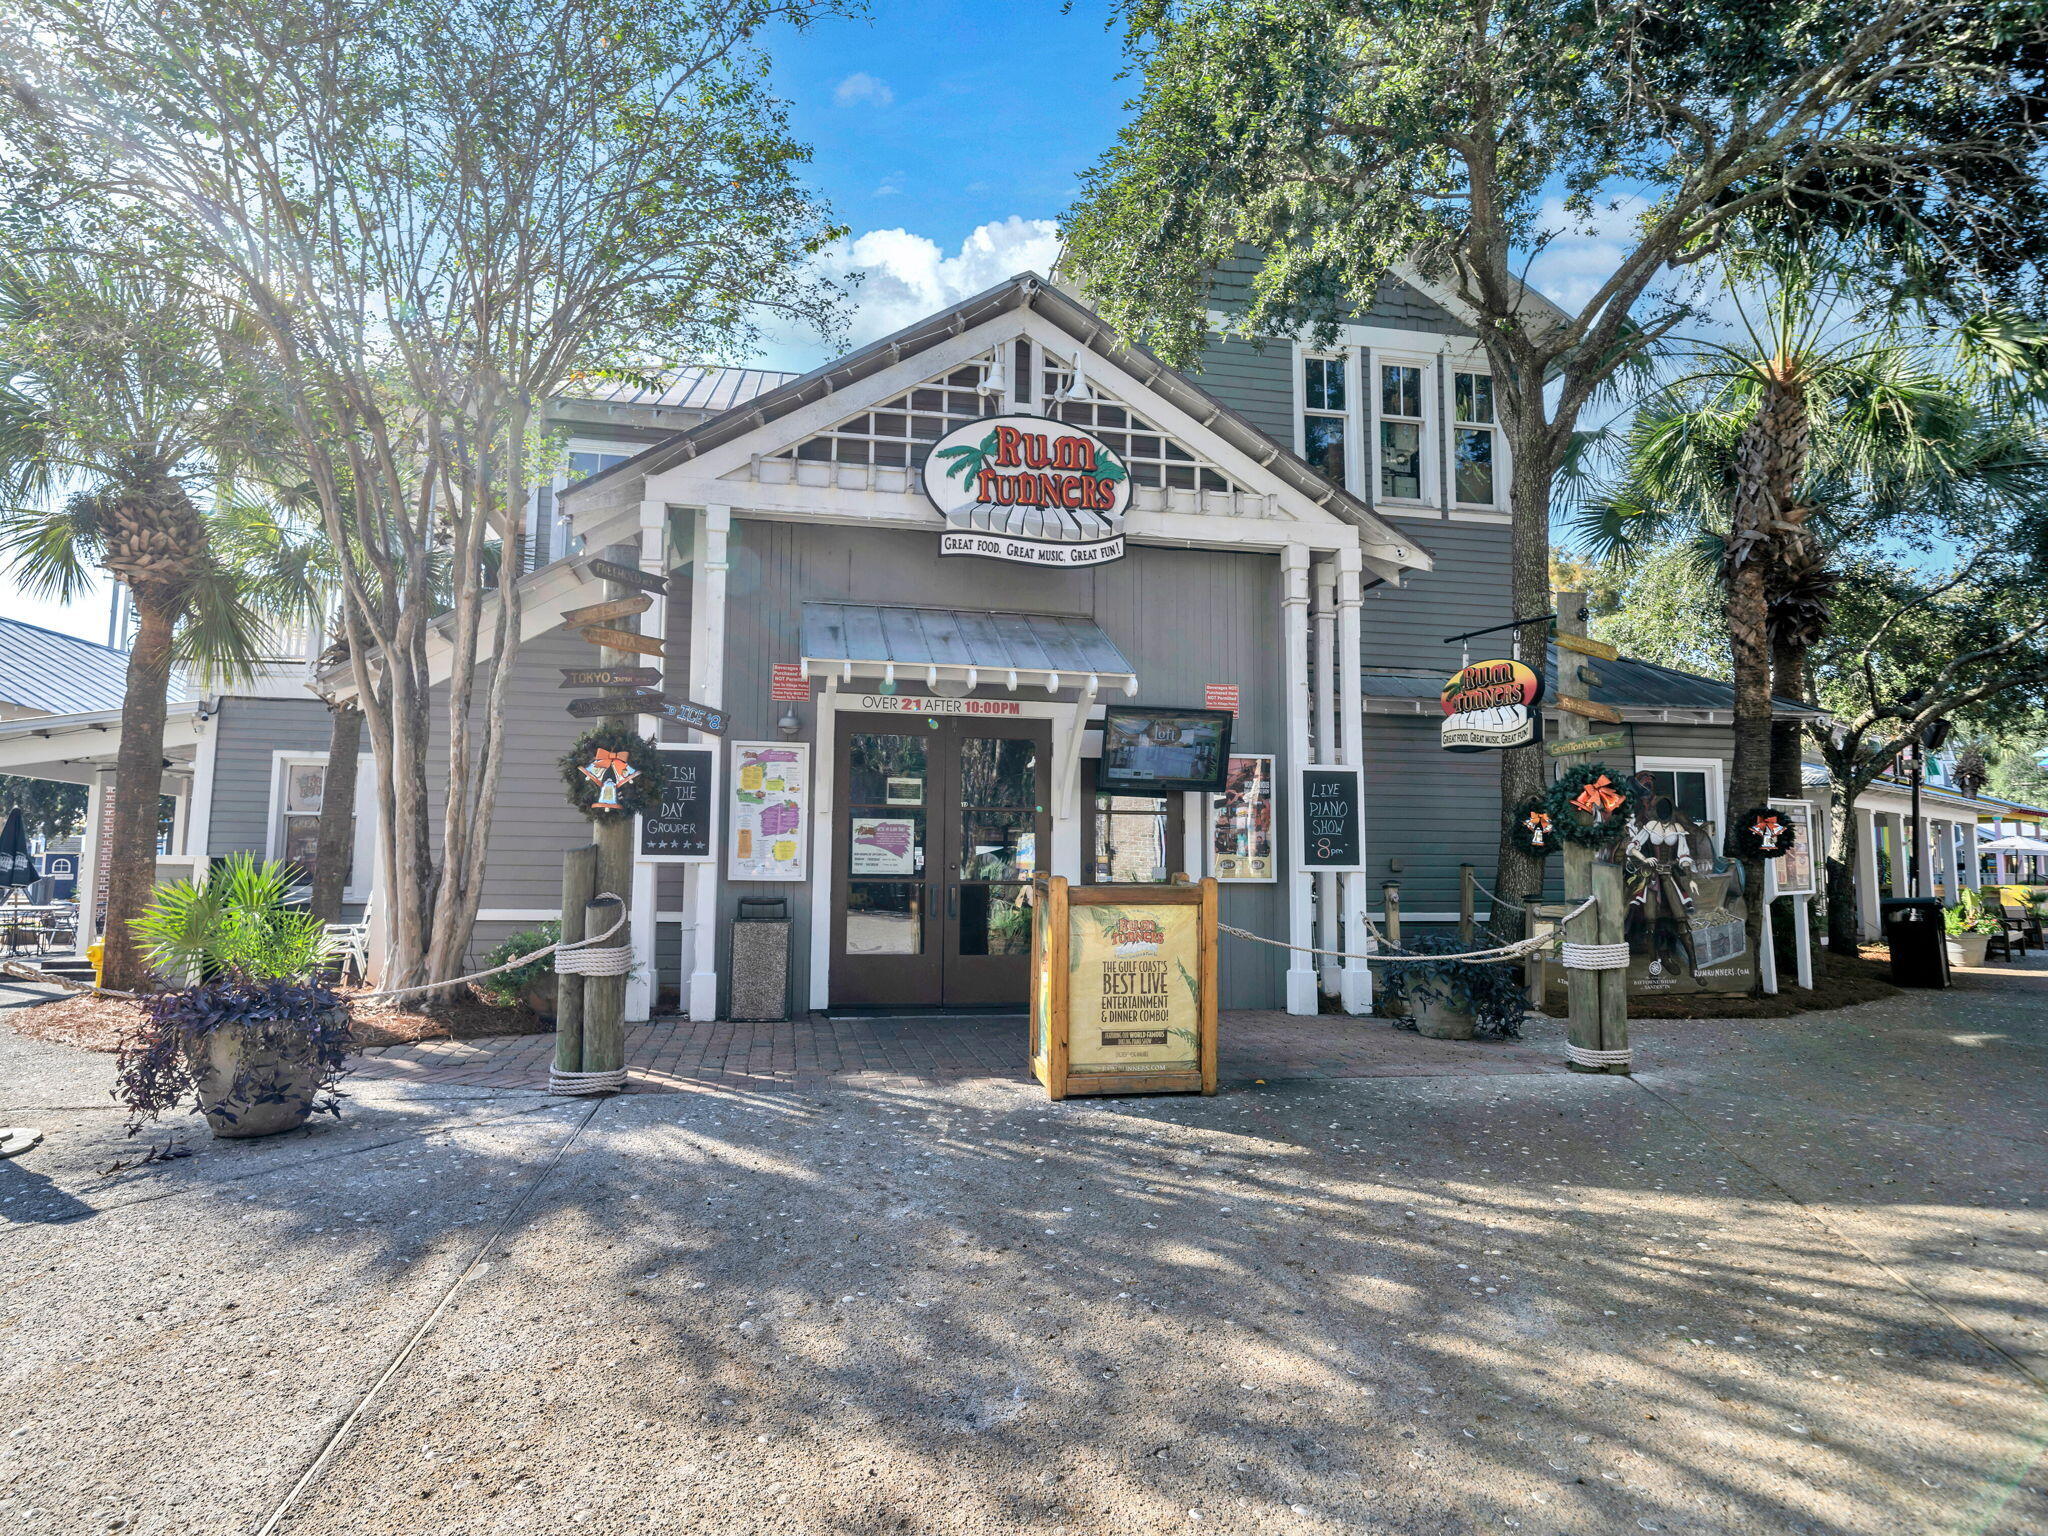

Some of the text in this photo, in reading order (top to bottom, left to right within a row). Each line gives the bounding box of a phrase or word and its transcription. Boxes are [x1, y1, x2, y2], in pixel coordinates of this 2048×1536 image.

[945, 537, 974, 551] GREAT
[1006, 543, 1034, 560] GREAT
[1038, 550, 1066, 563] MUSIC,
[1070, 549, 1098, 562] GREAT
[1100, 542, 1121, 558] FUN!
[570, 671, 611, 684] TOKYO
[862, 696, 1020, 715] OVER 21 AFTER 10:00PM
[677, 704, 707, 727] ICE
[1443, 733, 1456, 745] GREAT
[1470, 732, 1485, 744] GREAT
[1501, 733, 1517, 744] GREAT
[662, 764, 696, 781] ISH
[675, 786, 697, 800] THE
[1311, 783, 1341, 798] LIVE
[661, 802, 685, 818] DAY
[1309, 800, 1348, 818] PIANO
[647, 819, 697, 834] GROUPER
[1312, 819, 1345, 836] SHOW
[1102, 960, 1168, 973] THE GULF COAST'S
[1693, 968, 1750, 978] RUMRUNNERS.COM
[1103, 972, 1168, 995] BEST LIVE
[1101, 995, 1169, 1010] ENTERTAINMENT
[1101, 1009, 1169, 1023] & DINNER COMBO!
